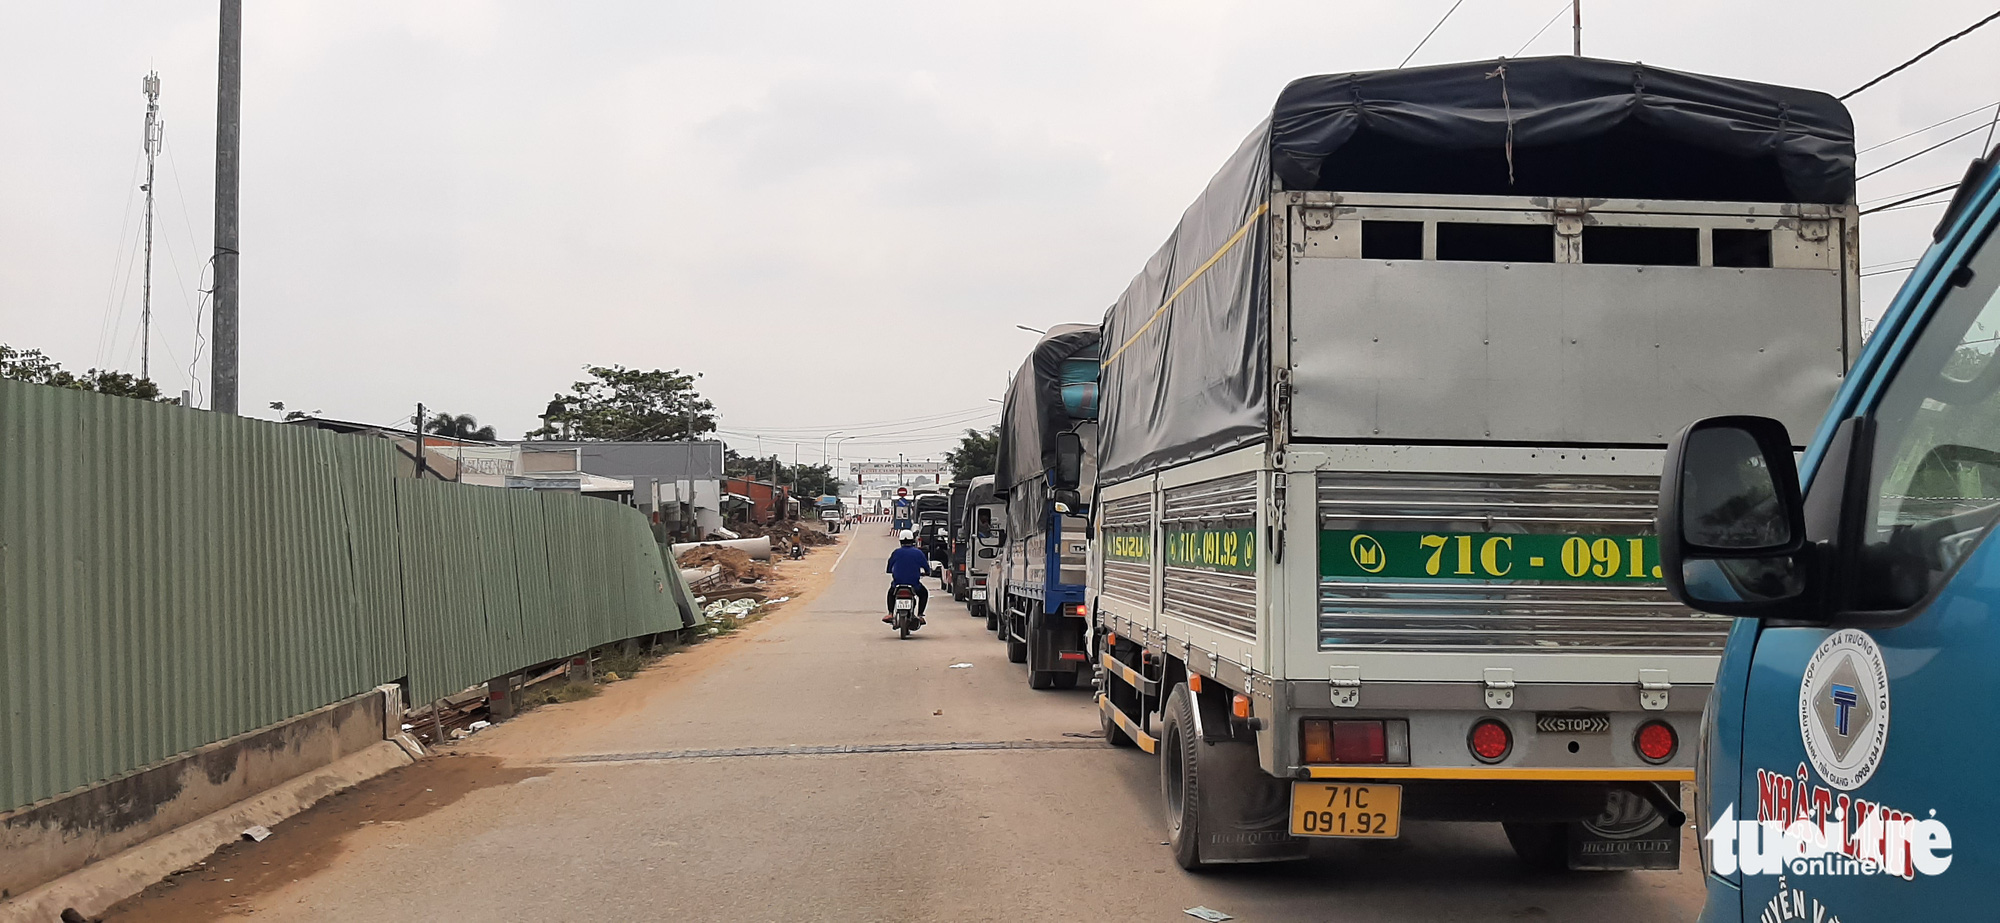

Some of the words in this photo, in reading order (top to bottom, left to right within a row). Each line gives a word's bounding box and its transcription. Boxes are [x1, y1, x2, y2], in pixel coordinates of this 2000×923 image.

[1112, 536, 1144, 558] ISUZU
[1180, 532, 1196, 563] 71C
[1202, 531, 1238, 567] 091.92
[1419, 534, 1513, 577] 71C
[1560, 537, 1663, 579] 091.
[1815, 642, 1830, 663] TÁC
[1556, 718, 1591, 731] STOP
[1868, 745, 1880, 766] 834
[1876, 723, 1885, 746] 244
[1829, 772, 1849, 787] GIANG
[1324, 786, 1370, 809] 71C
[1303, 810, 1387, 834] 091.92
[1582, 843, 1614, 853] HIGH
[1616, 842, 1671, 854] QUALITY
